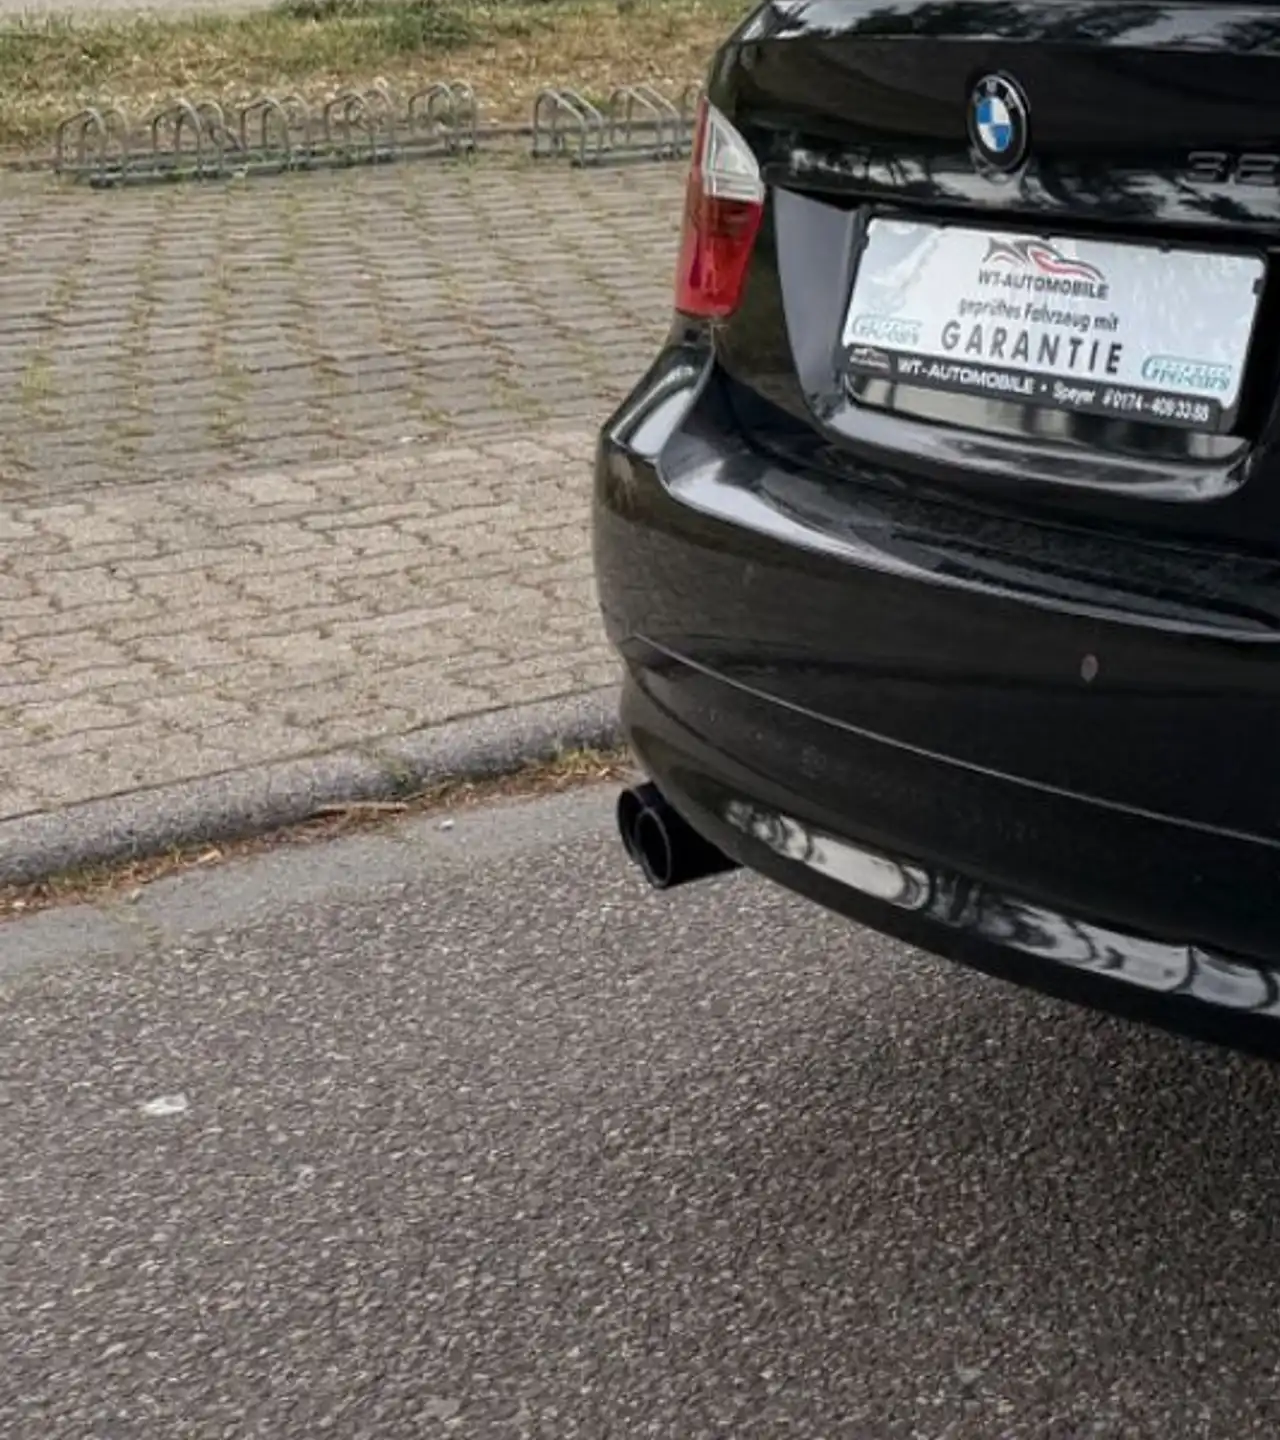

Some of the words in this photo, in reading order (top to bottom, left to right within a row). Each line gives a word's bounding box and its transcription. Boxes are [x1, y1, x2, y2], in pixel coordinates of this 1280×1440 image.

[978, 269, 1110, 300] WT-AUTOMOBILE
[1023, 302, 1091, 332] Fahrzeug
[1094, 312, 1119, 332] mit
[941, 320, 1123, 375] GARANTIE
[897, 356, 1036, 395] WT-AUTOMOBILE
